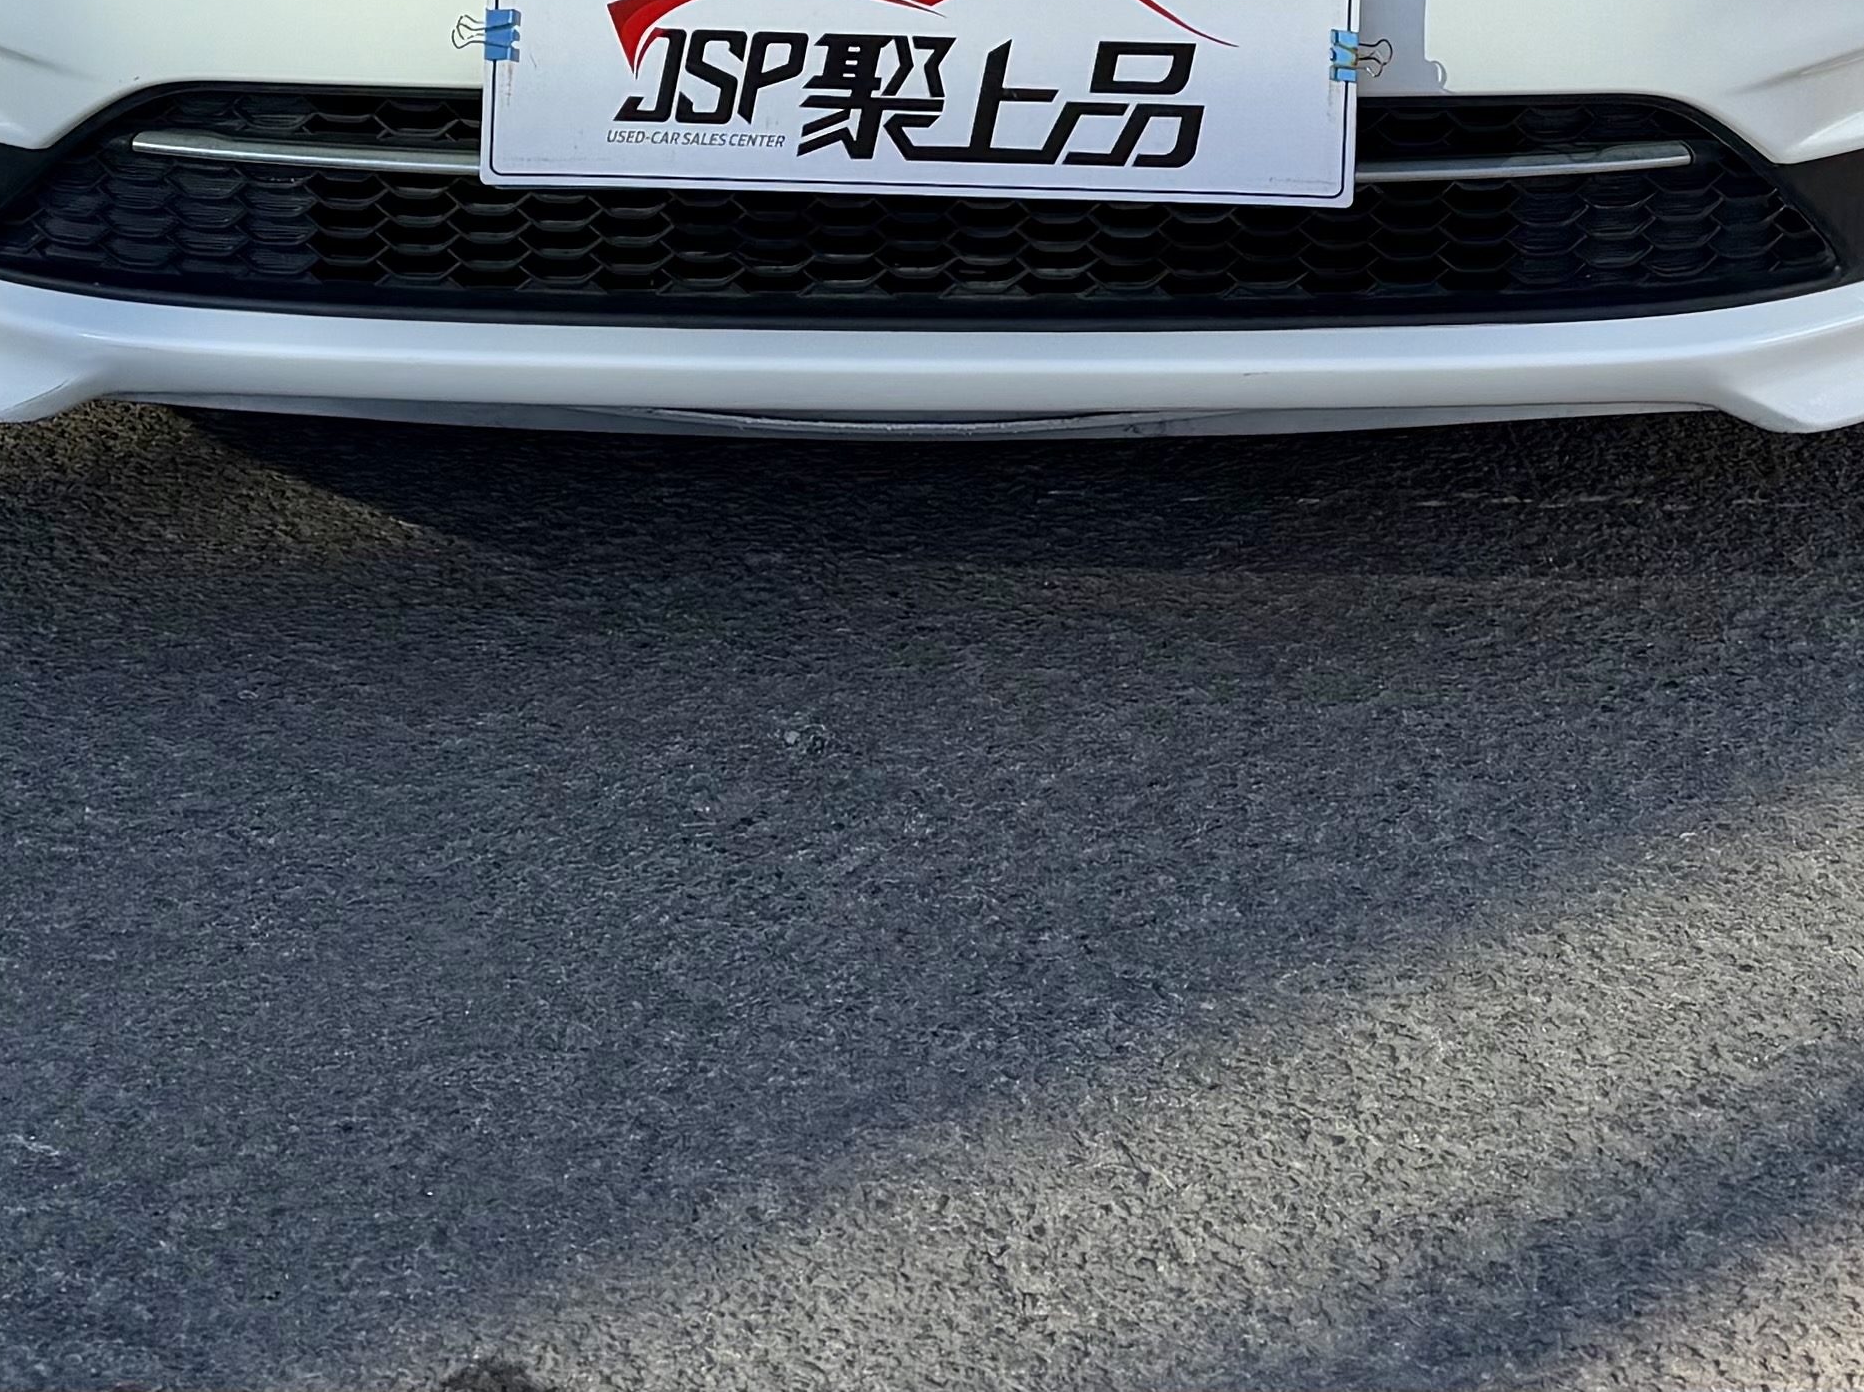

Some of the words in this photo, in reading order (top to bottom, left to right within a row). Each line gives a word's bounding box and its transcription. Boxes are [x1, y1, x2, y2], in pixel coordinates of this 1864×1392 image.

[606, 129, 684, 146] USED-CAR
[681, 132, 727, 147] SALES
[728, 133, 786, 148] CENTER
